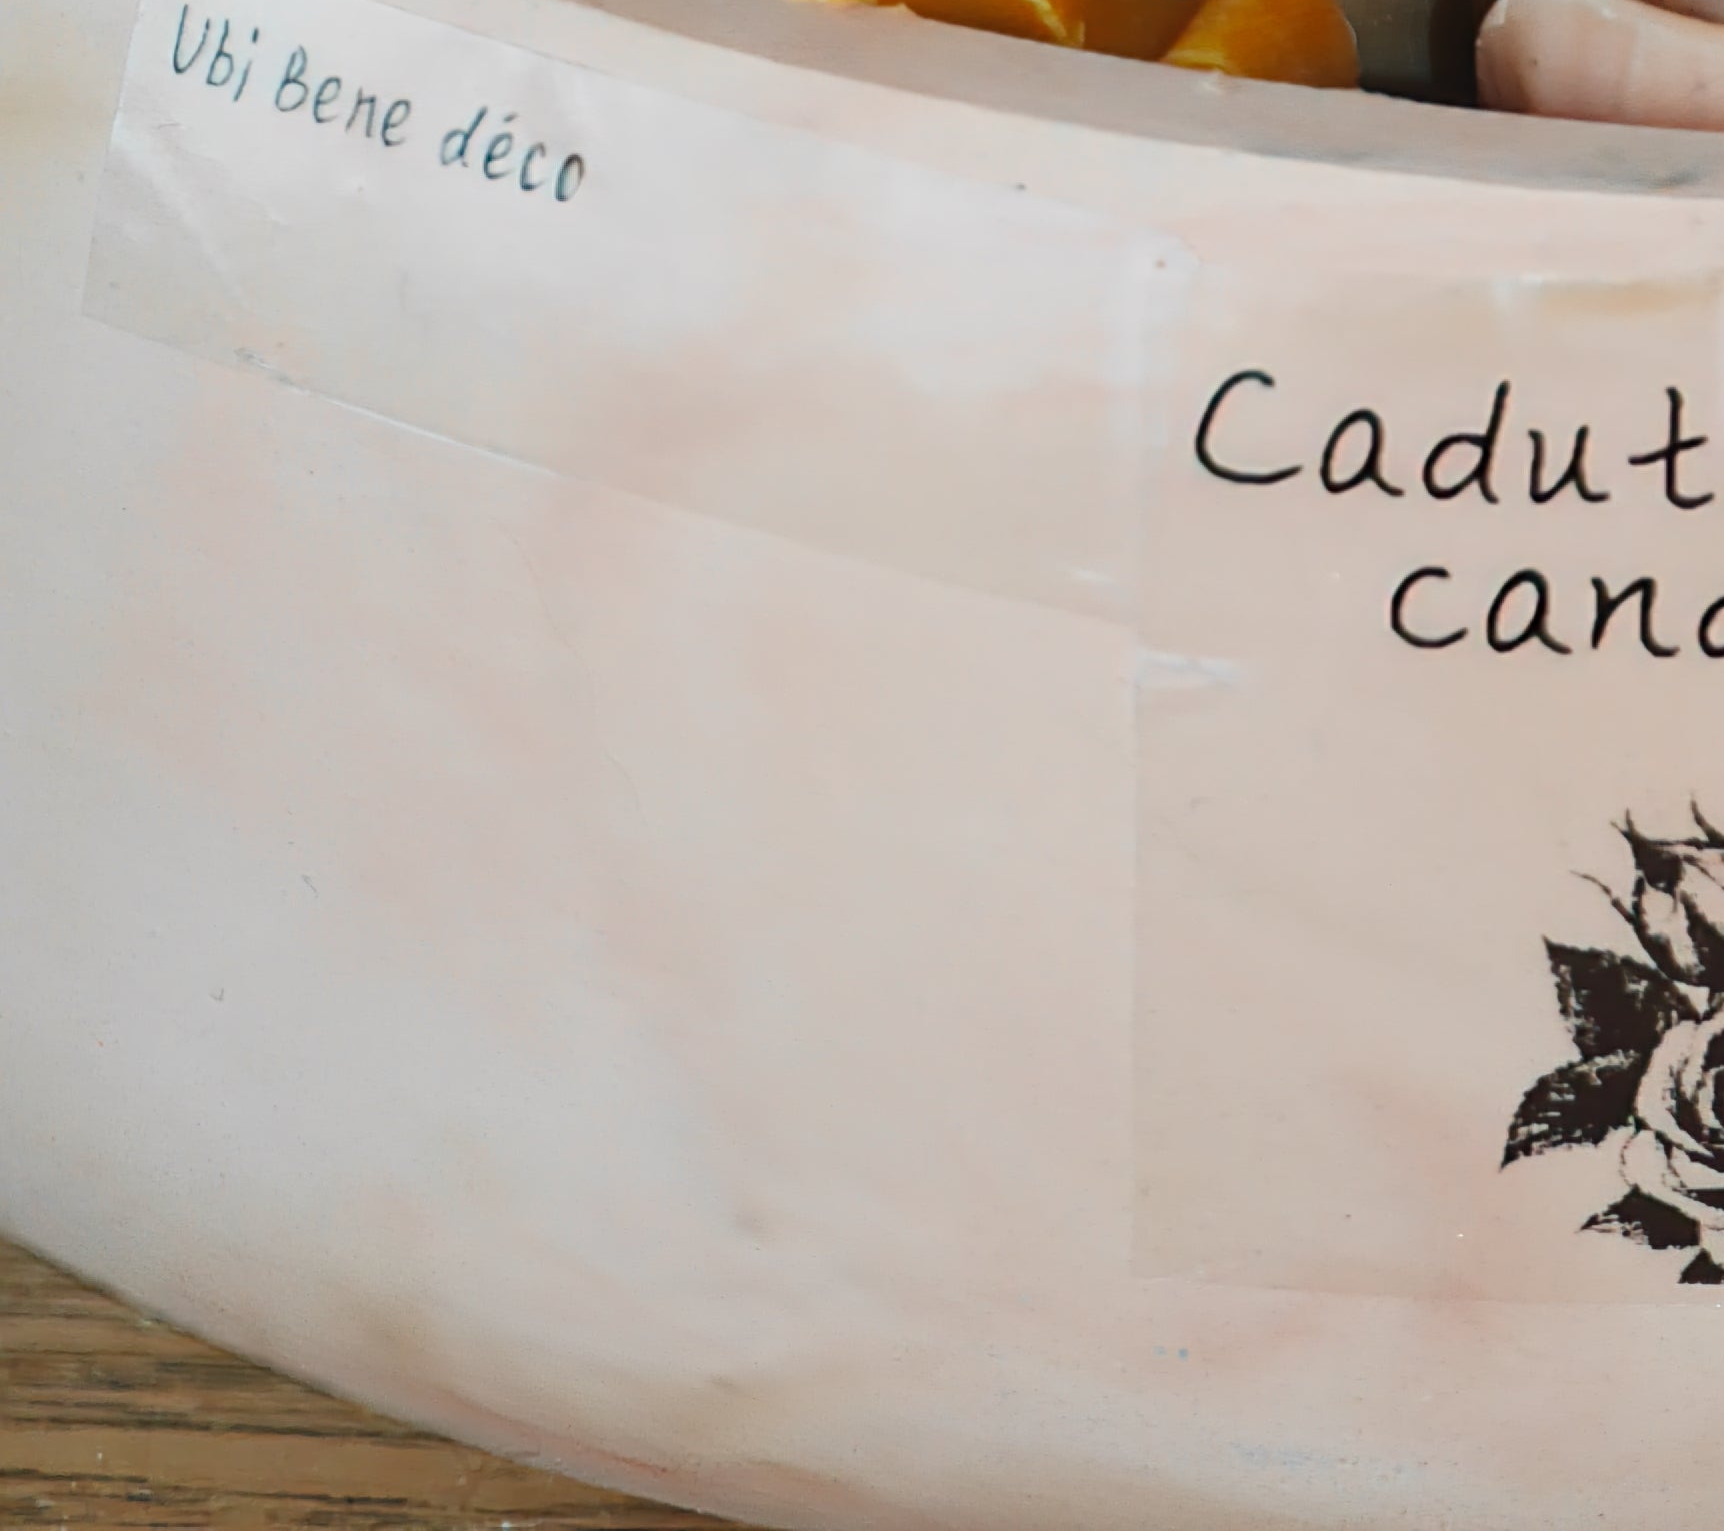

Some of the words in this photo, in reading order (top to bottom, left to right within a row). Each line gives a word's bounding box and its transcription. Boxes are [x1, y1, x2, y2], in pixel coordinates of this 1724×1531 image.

[171, 2, 261, 103] Ubi
[273, 44, 413, 148] Bene
[438, 106, 588, 203] déco
